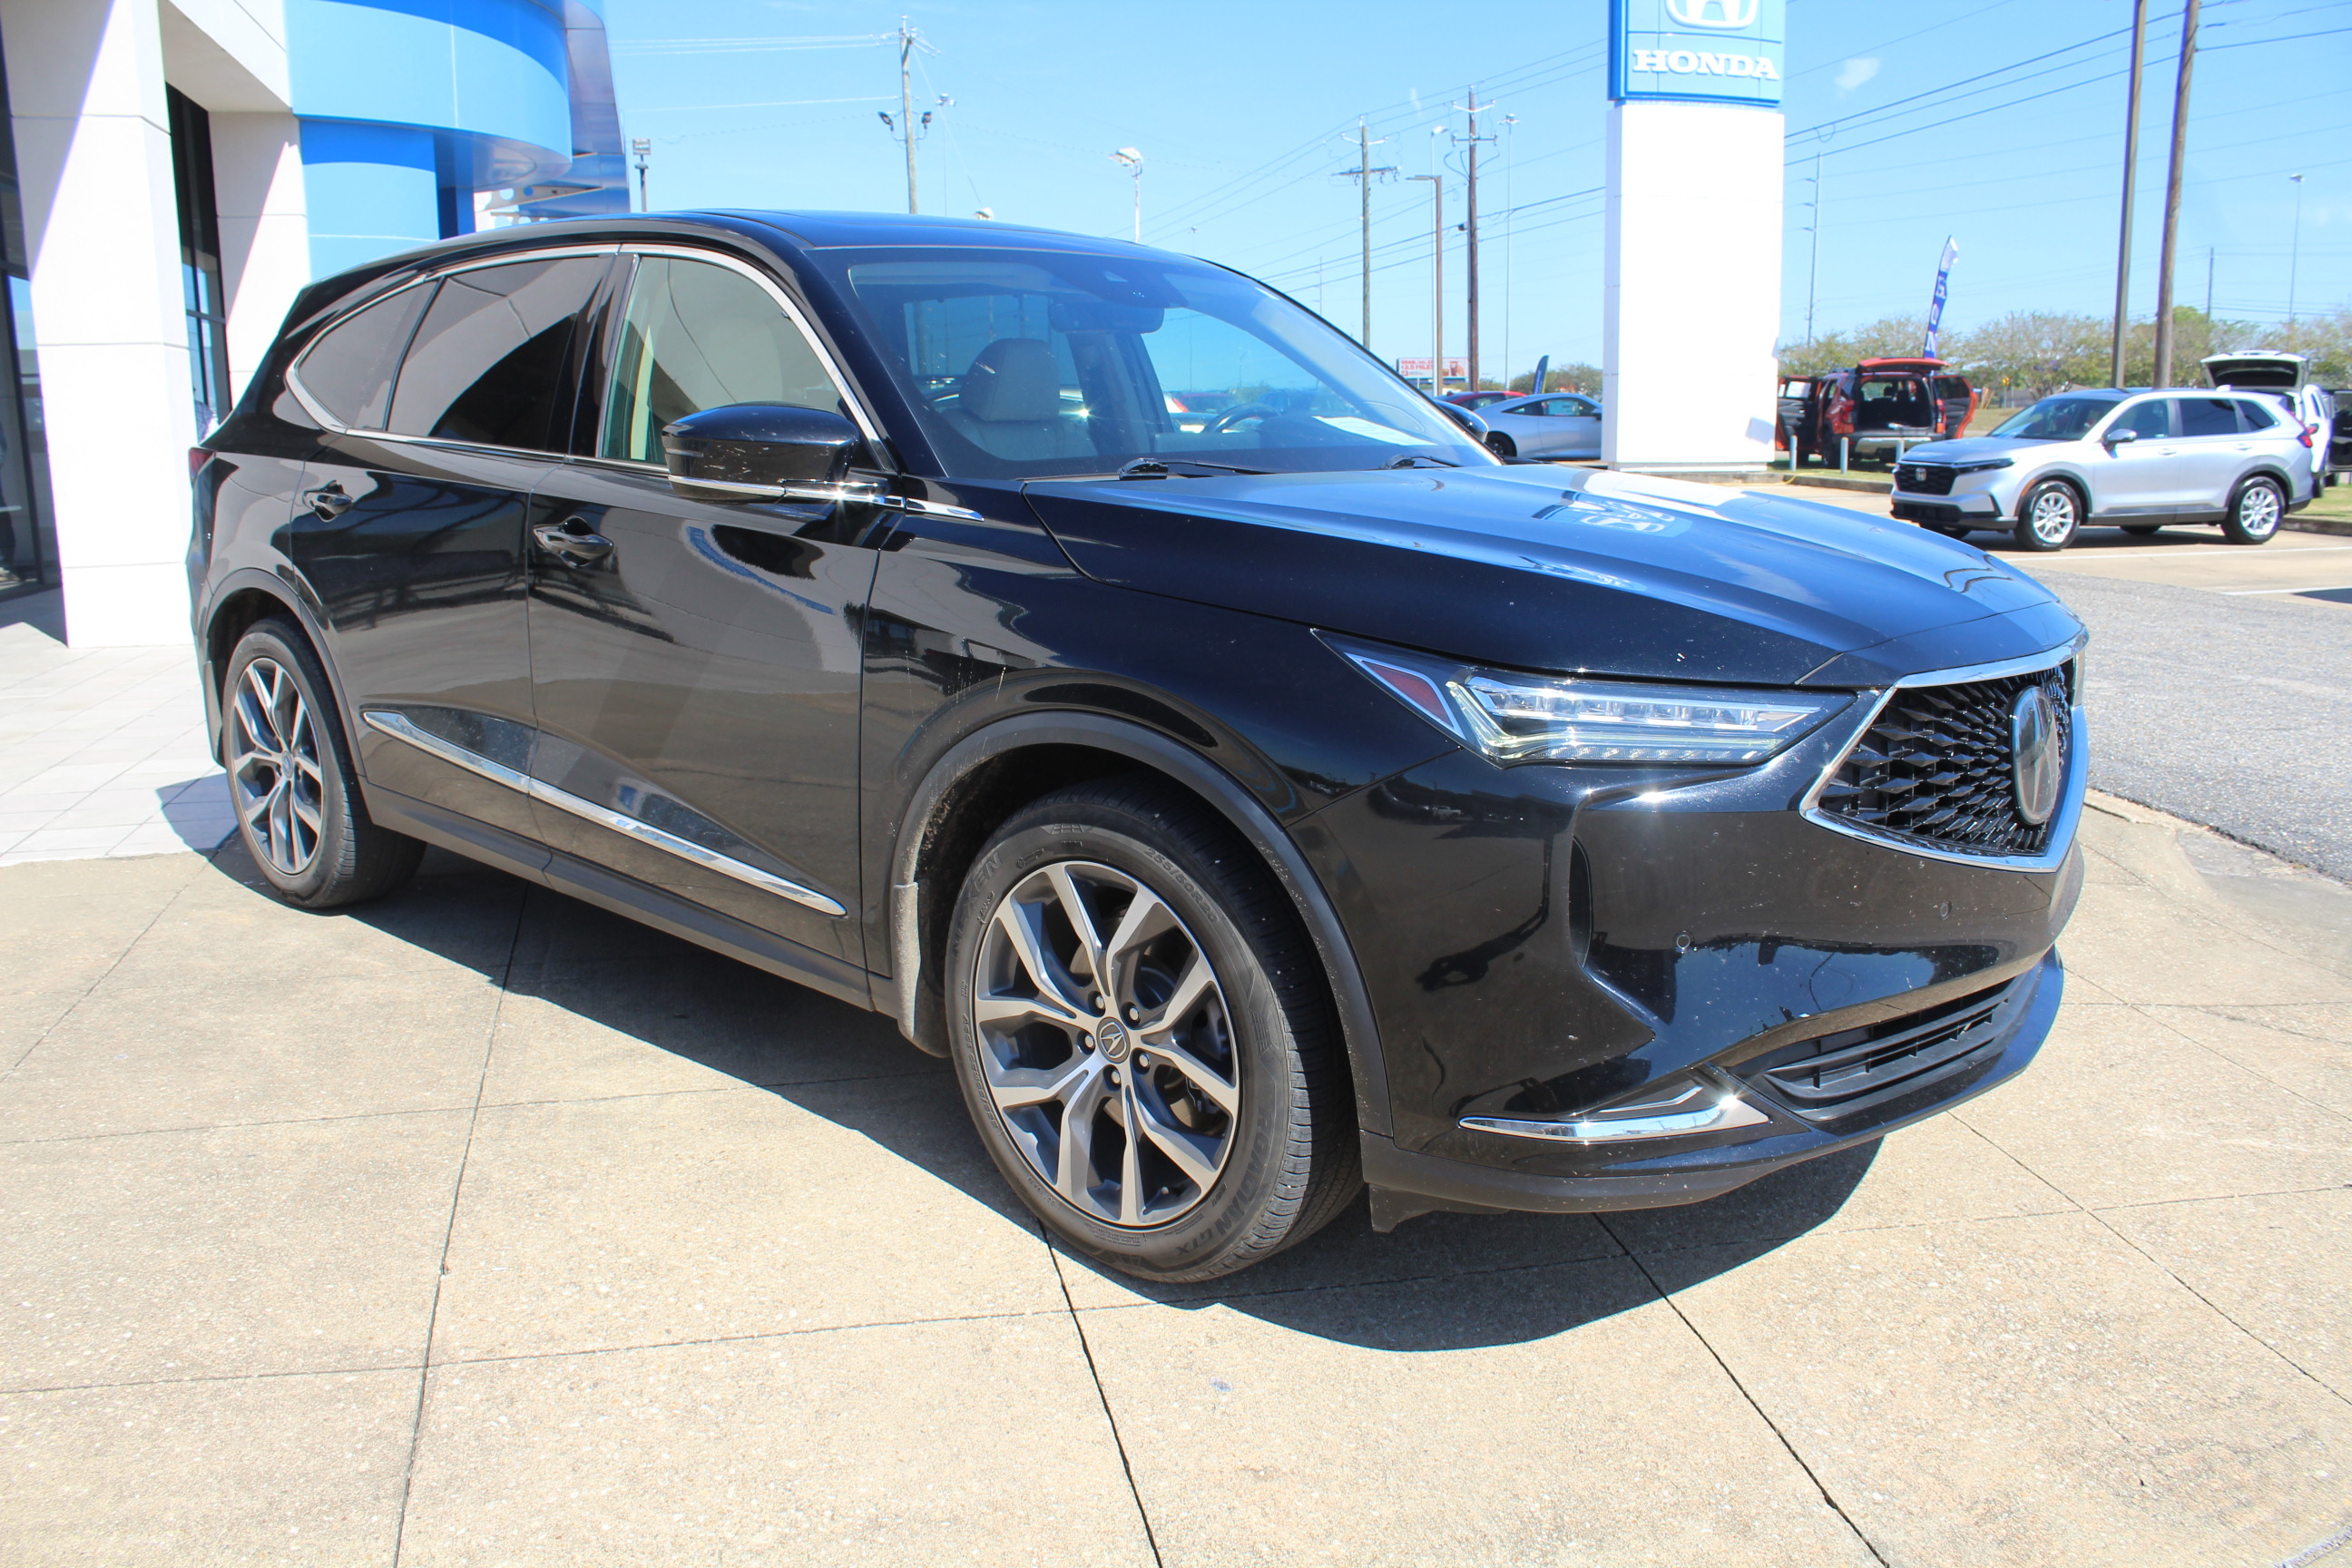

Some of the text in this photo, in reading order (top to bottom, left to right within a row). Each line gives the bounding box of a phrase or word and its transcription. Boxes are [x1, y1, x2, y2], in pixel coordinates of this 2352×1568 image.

[1632, 50, 1780, 80] HONDA
[1145, 848, 1219, 923] 255/50R20
[1213, 1107, 1270, 1236] ROADIAN
[1176, 1228, 1213, 1256] GTX
